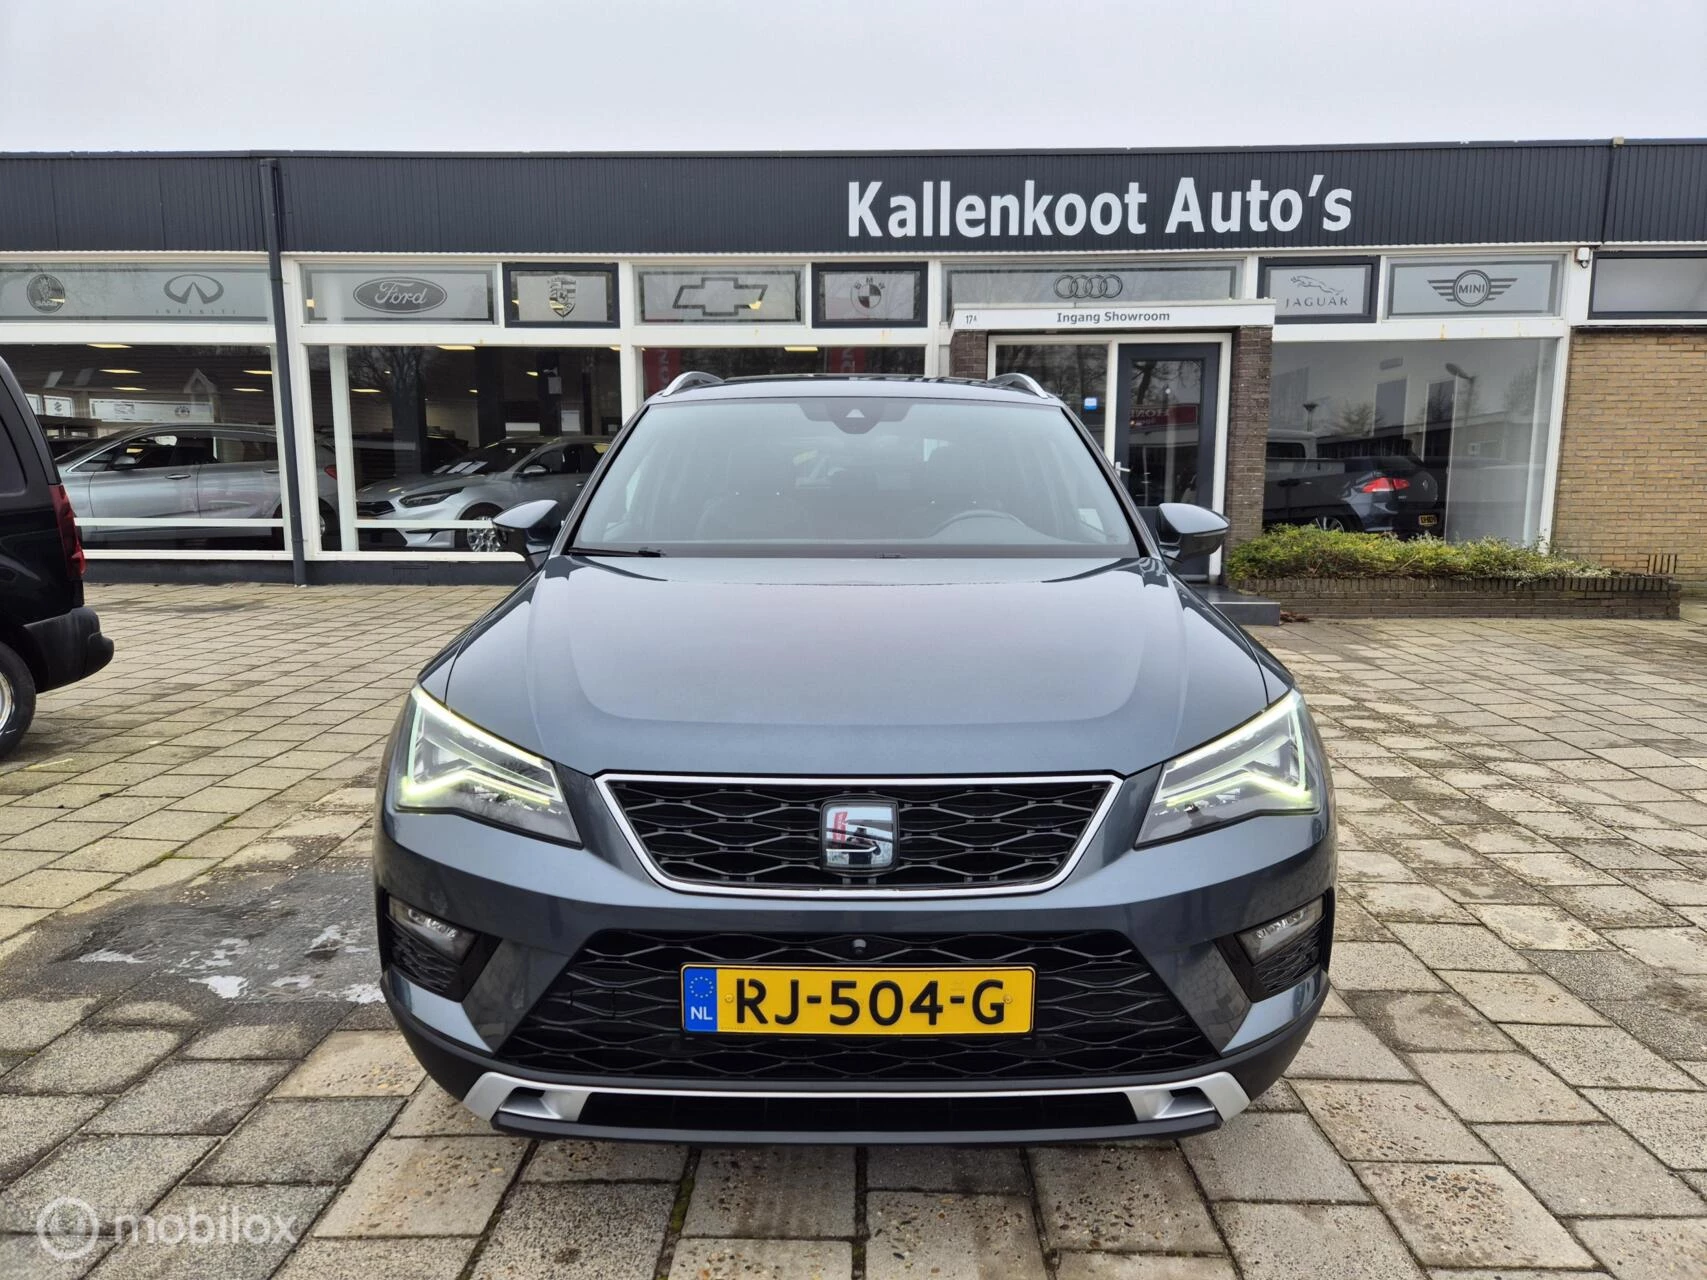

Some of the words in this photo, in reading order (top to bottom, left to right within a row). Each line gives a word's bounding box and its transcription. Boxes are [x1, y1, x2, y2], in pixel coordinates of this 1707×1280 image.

[848, 179, 1147, 237] Kallenkoot
[1165, 175, 1353, 233] Auto's
[374, 280, 428, 305] Ford
[1458, 284, 1486, 295] MINI
[1285, 296, 1349, 308] JAGUAR
[1057, 312, 1101, 324] Ingang
[1104, 311, 1170, 322] Showroom
[736, 978, 1006, 1027] RJ-504-G
[690, 1006, 713, 1021] NL
